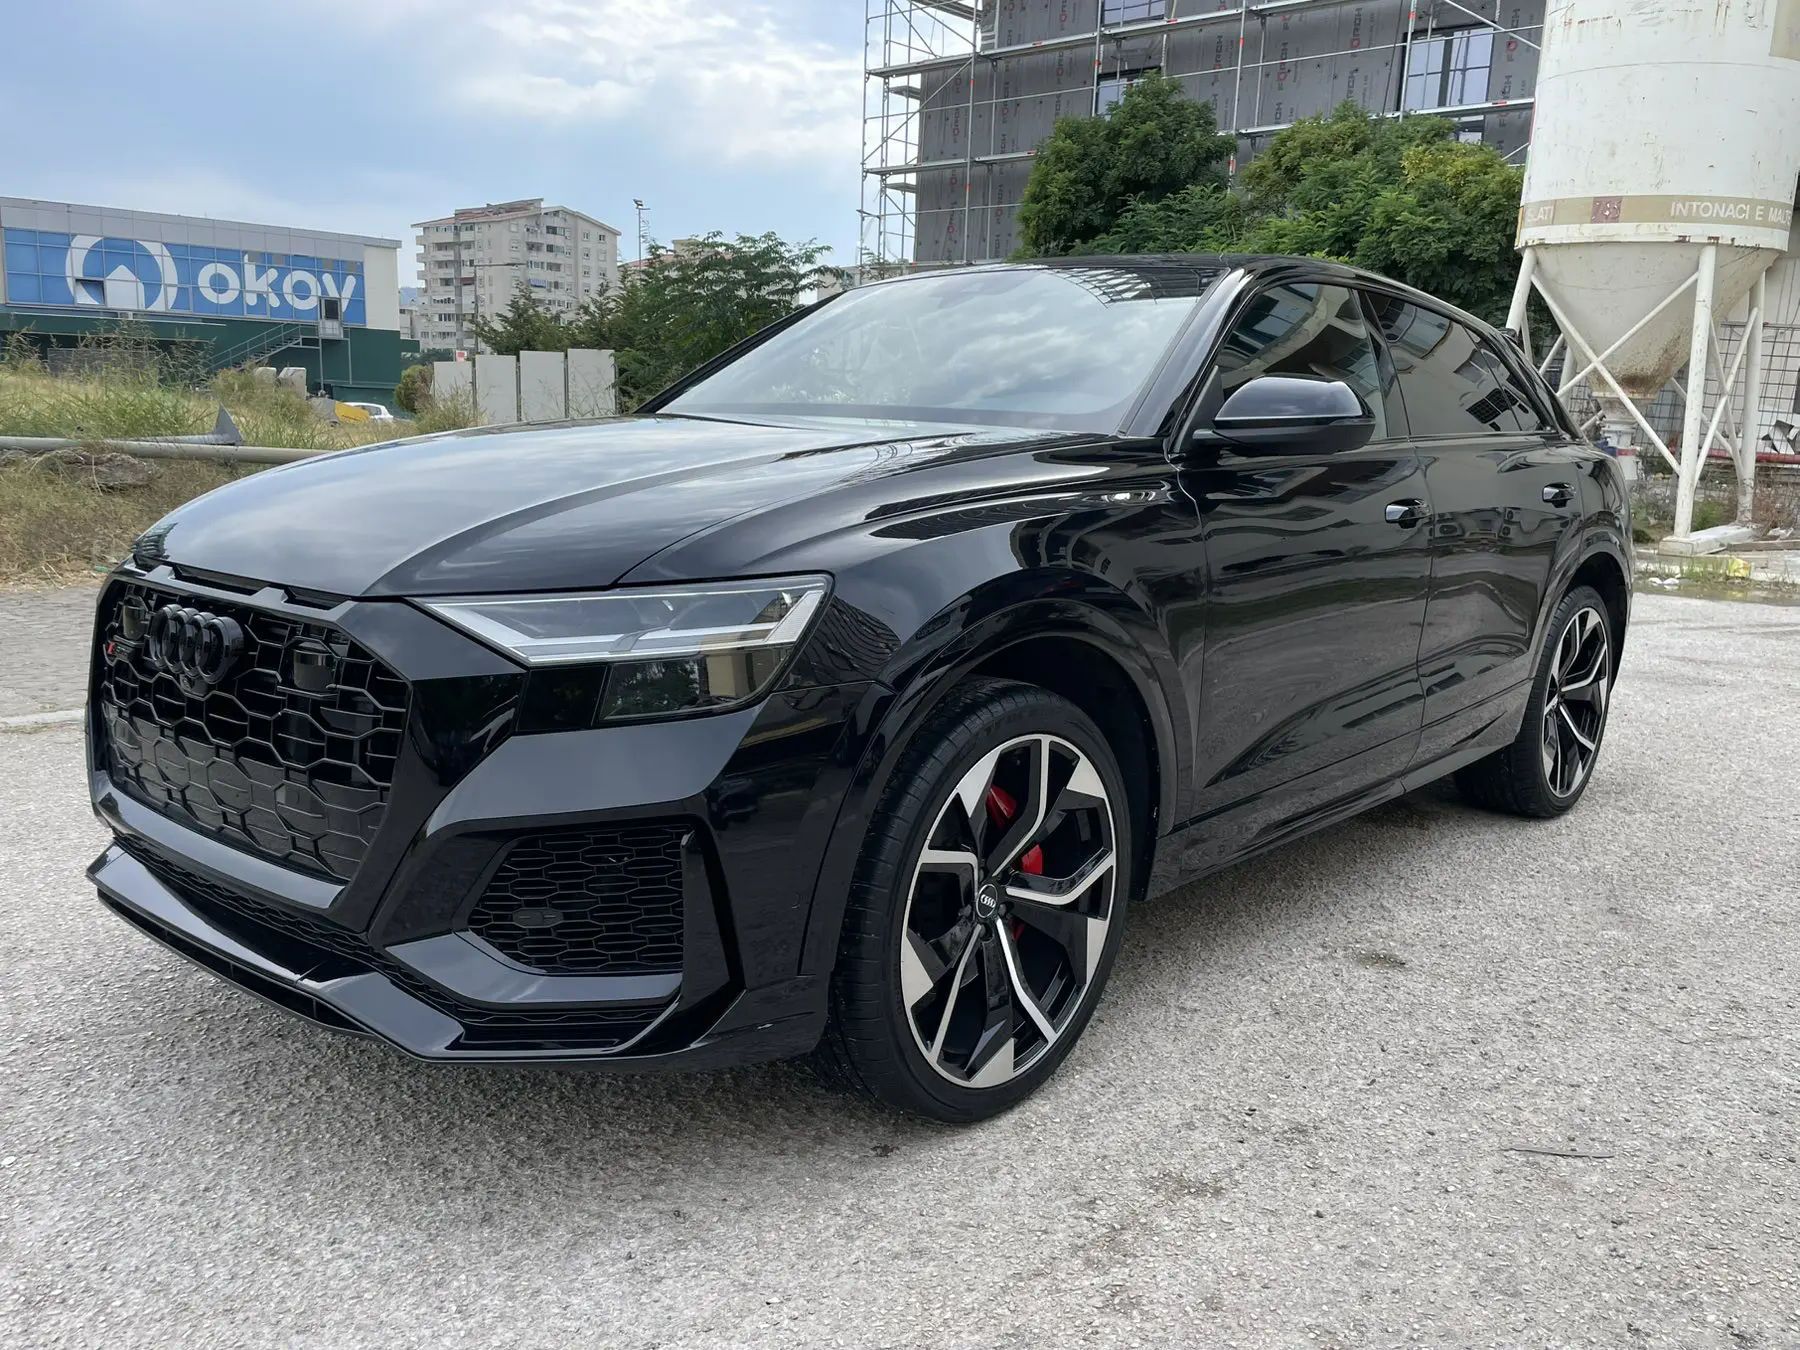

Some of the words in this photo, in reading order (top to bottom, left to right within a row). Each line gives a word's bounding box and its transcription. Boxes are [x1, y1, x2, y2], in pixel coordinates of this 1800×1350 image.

[1670, 201, 1750, 219] INTONACI
[1755, 206, 1764, 220] E
[198, 252, 357, 312] okov
